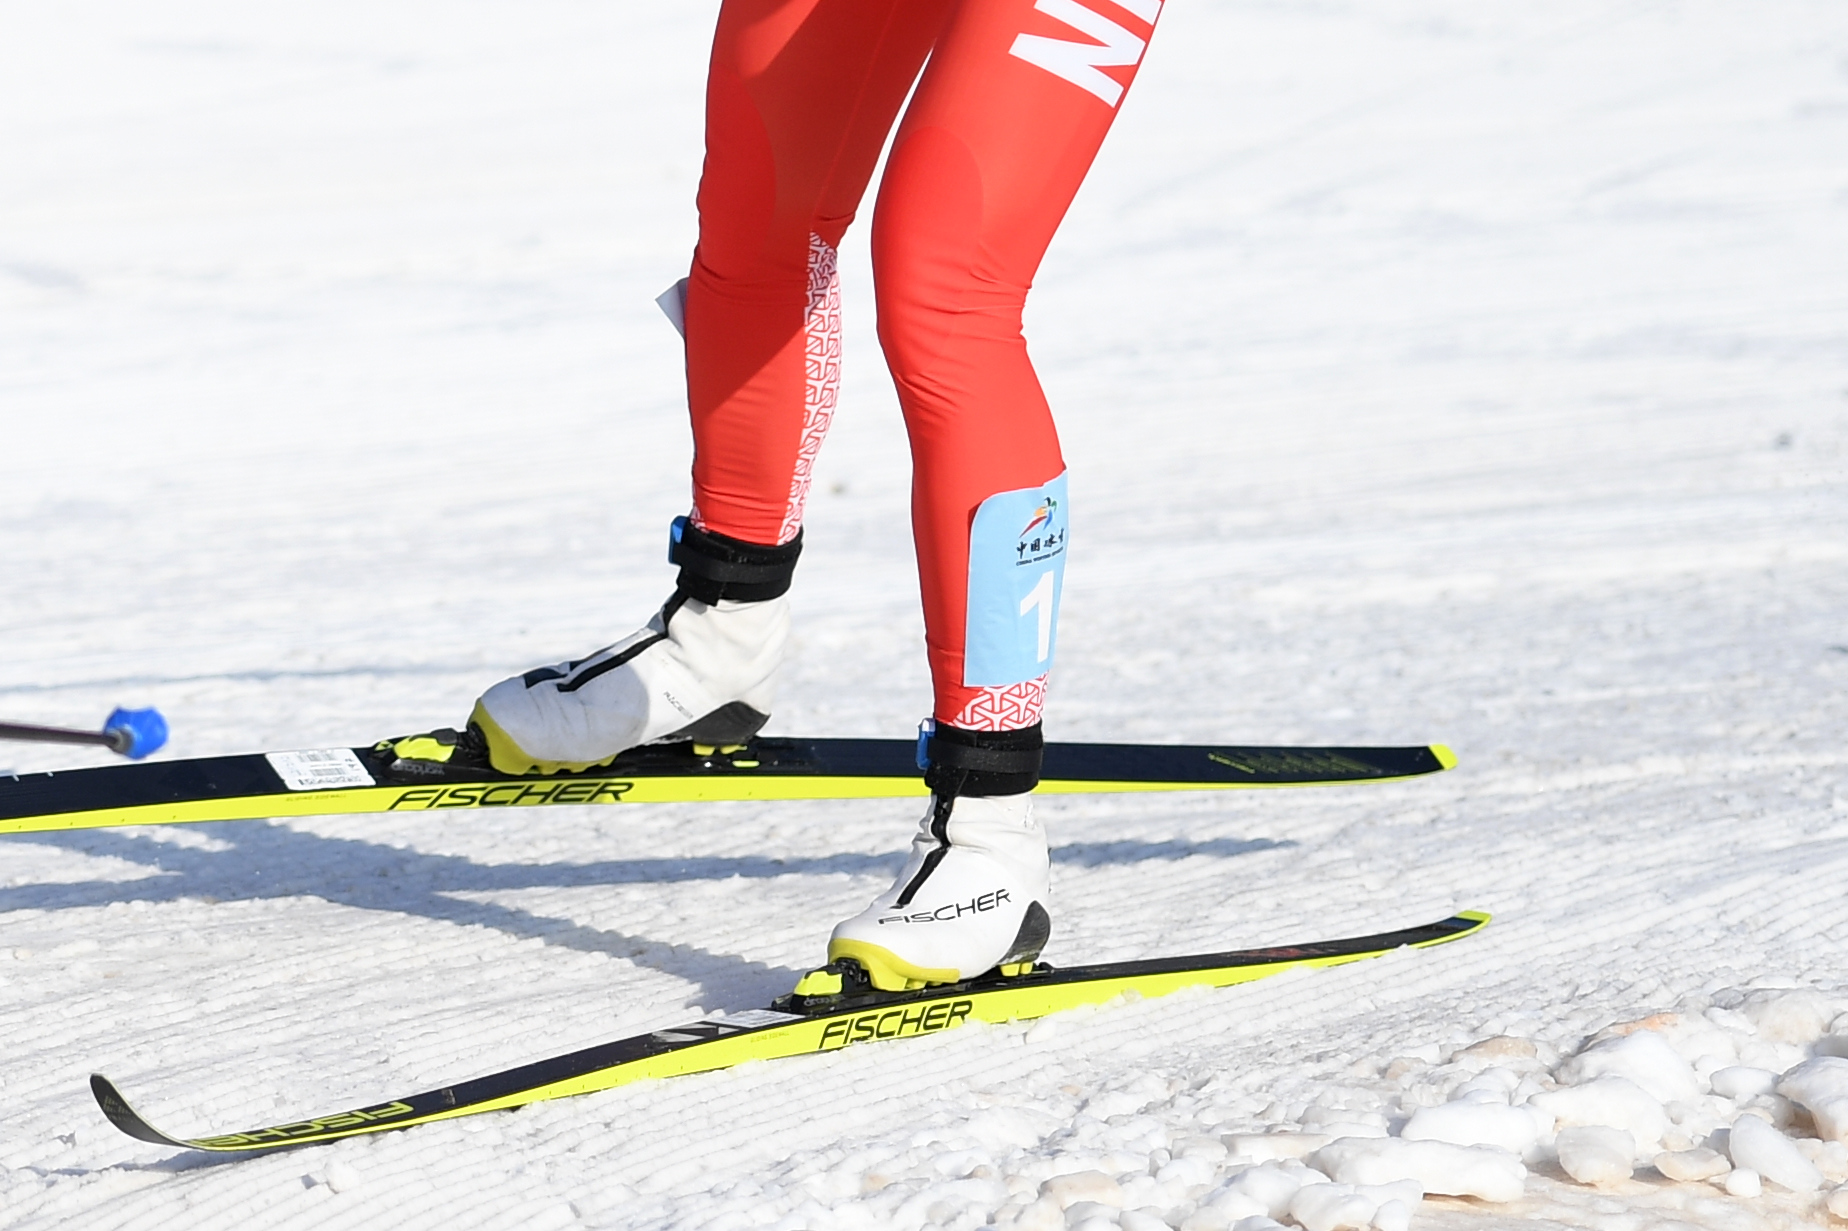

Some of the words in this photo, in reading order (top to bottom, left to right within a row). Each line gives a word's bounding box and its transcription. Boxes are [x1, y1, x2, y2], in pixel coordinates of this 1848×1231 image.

[1020, 570, 1055, 663] 1
[387, 781, 634, 810] FISCHER
[878, 888, 1011, 925] FISCHER
[819, 1000, 973, 1049] FISCHER
